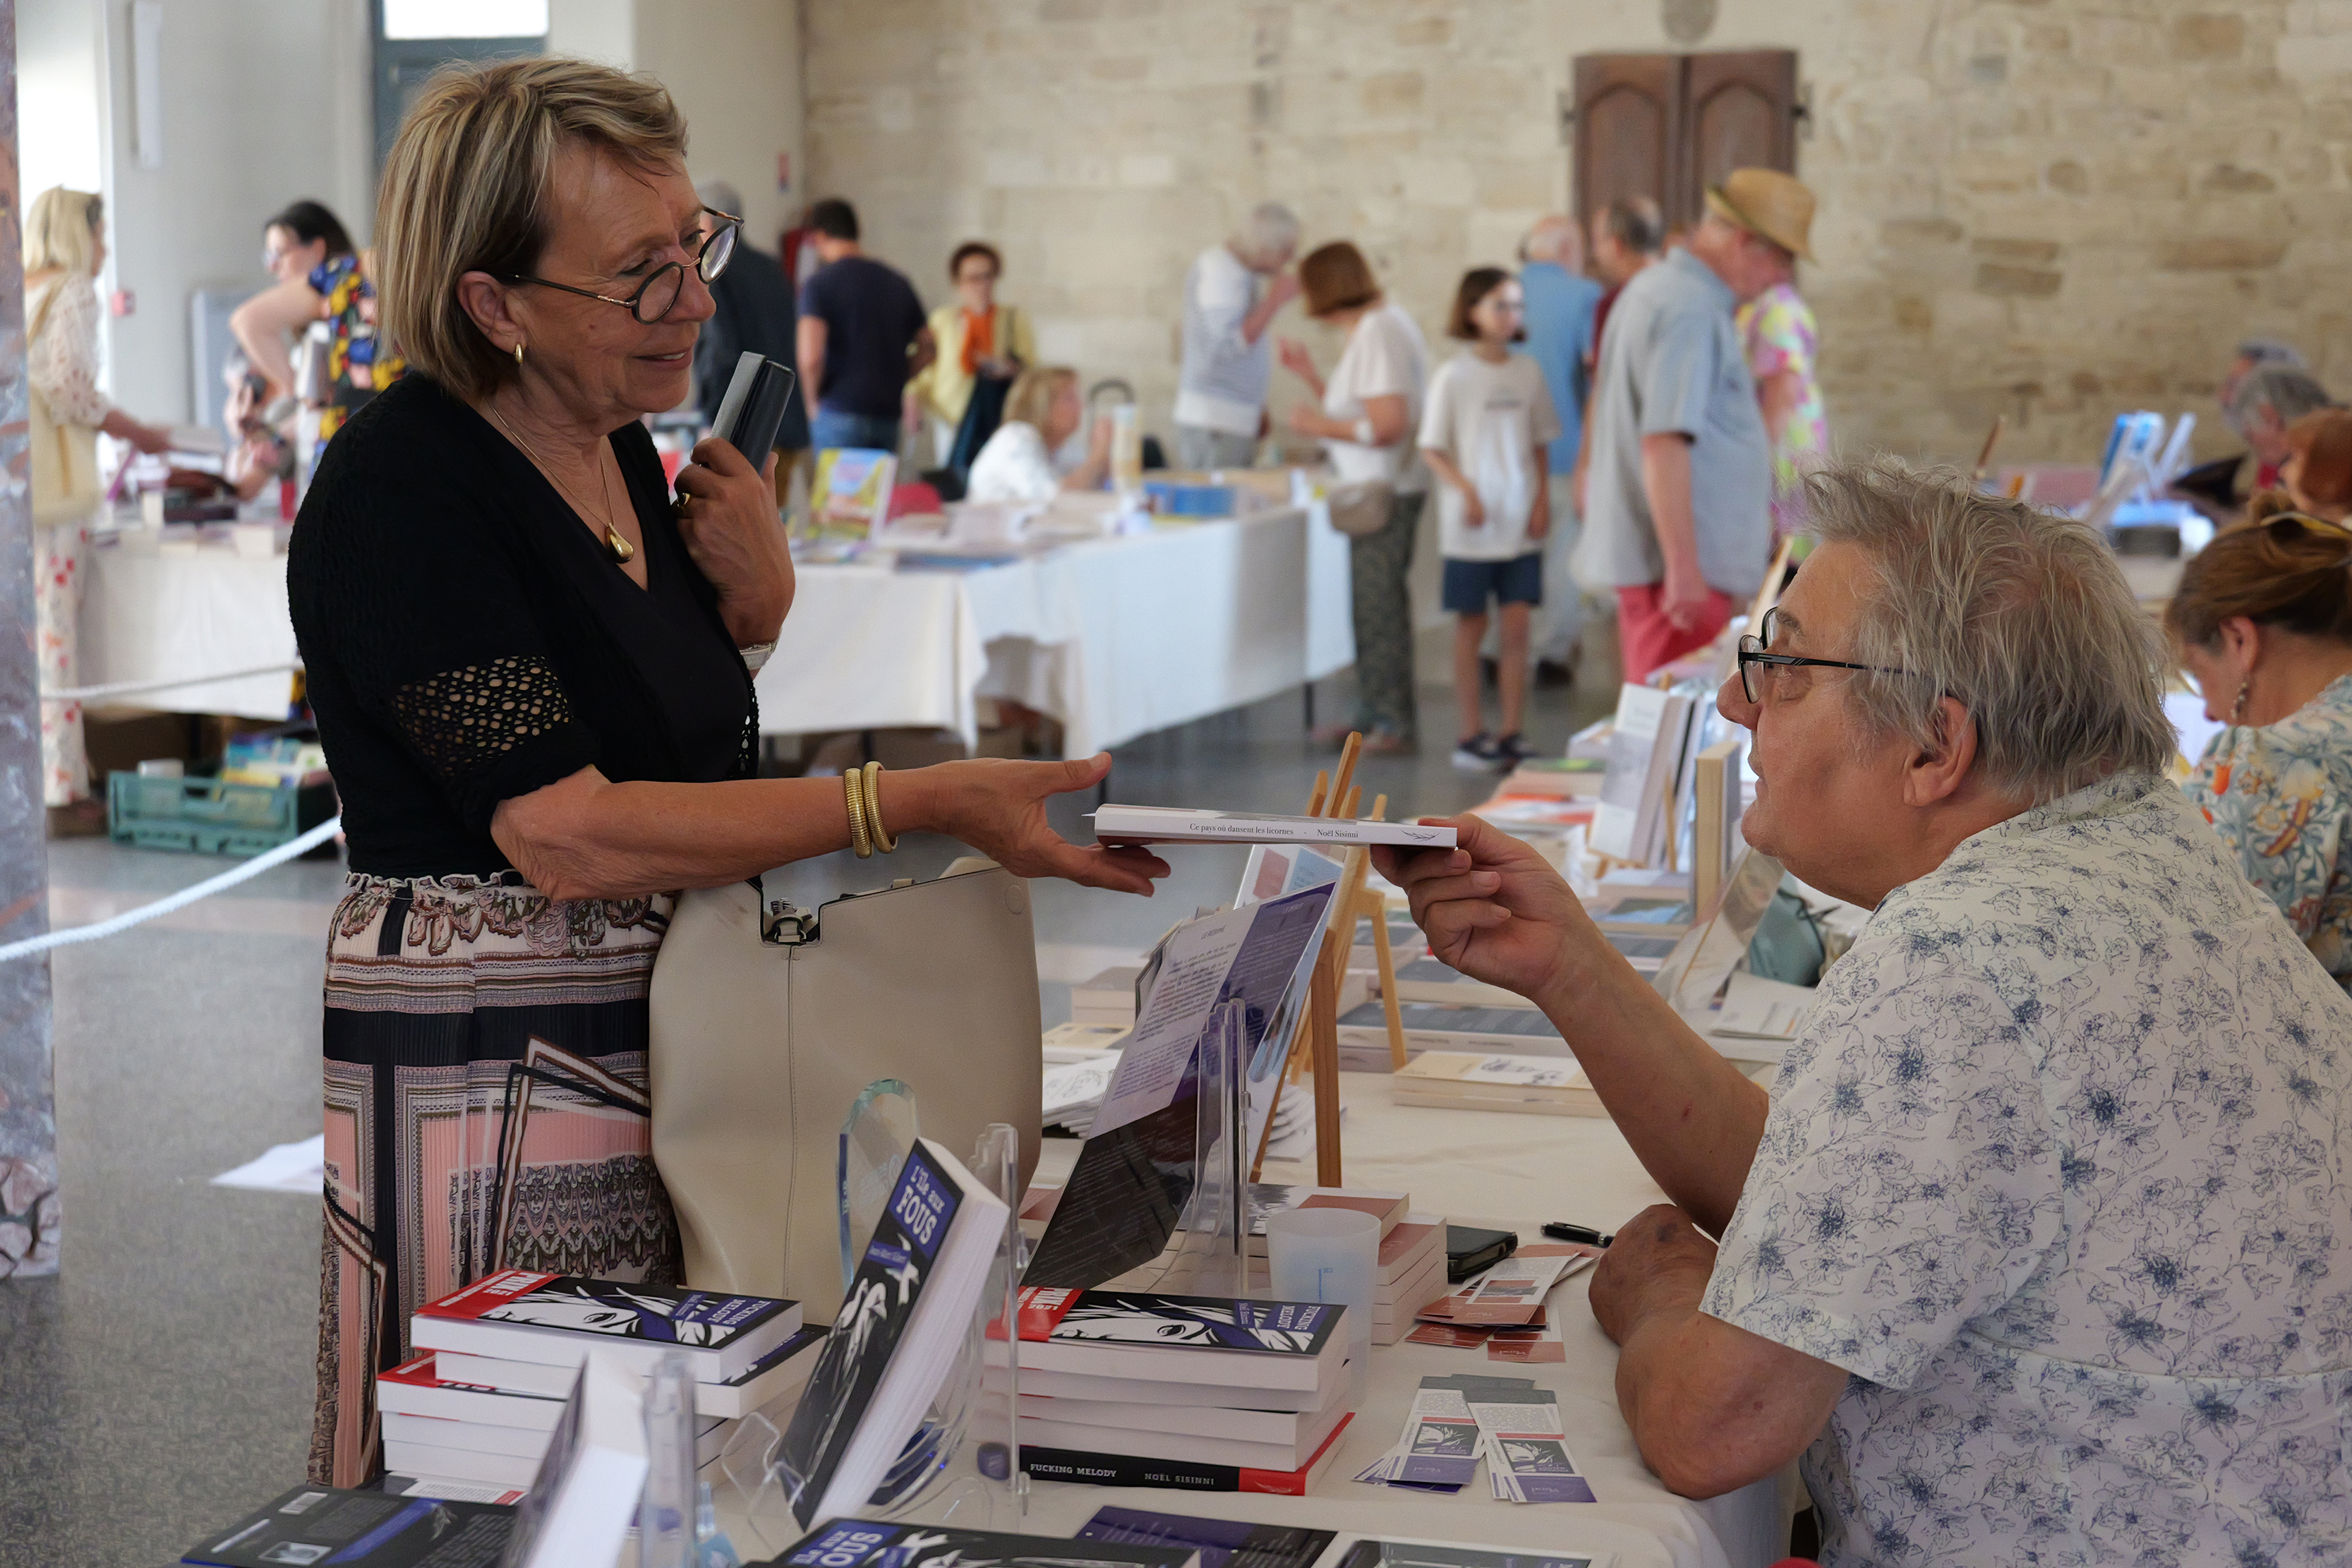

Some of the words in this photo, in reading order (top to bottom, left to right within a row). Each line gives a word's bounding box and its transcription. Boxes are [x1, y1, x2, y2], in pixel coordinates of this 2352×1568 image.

[1201, 825, 1216, 833] pays
[1228, 825, 1254, 833] dansent
[1267, 826, 1293, 835] licornes
[1334, 830, 1358, 838] Sisinni
[927, 1190, 946, 1214] aux
[895, 1184, 938, 1245] FOUS
[483, 1288, 514, 1296] 2021
[707, 1298, 747, 1323] MELODY
[722, 1301, 772, 1326] FUCKING
[1277, 1305, 1296, 1329] MELODY
[1294, 1305, 1322, 1331] FUCKING
[1030, 1463, 1073, 1474] FUCKING
[1077, 1467, 1117, 1478] MELODY
[1175, 1475, 1215, 1485] SISINNI
[820, 1532, 883, 1567] OUS
